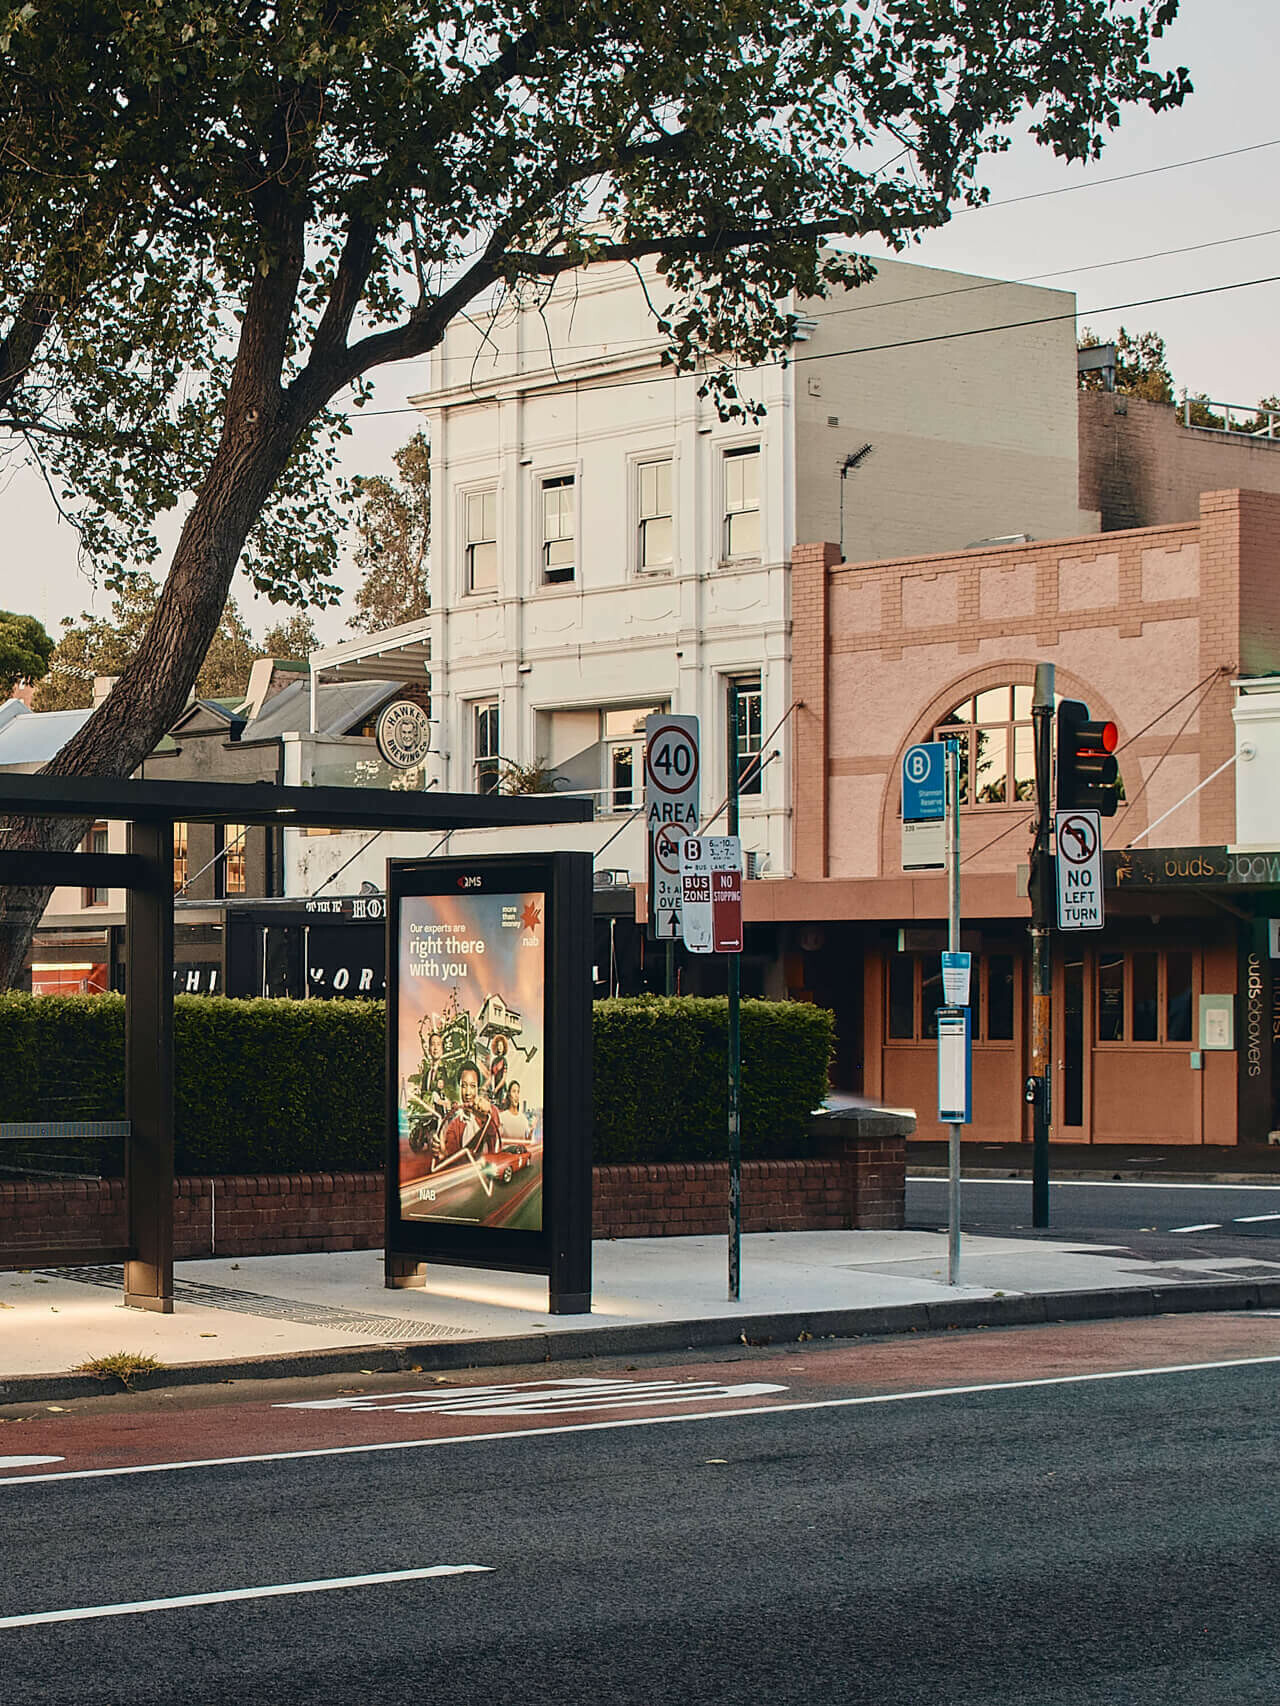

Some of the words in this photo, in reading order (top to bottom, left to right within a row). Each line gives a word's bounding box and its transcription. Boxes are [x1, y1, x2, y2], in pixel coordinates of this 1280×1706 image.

[387, 739, 420, 762] BREWING
[654, 744, 691, 777] 40
[913, 756, 923, 776] B
[648, 802, 697, 823] AREA
[687, 840, 699, 860] B
[685, 877, 708, 888] BUS
[720, 875, 733, 888] NO
[1067, 870, 1092, 887] NO
[684, 890, 710, 901] ZONE
[713, 891, 741, 902] STOPPING
[1065, 891, 1095, 904] LEFT
[352, 899, 387, 918] HO
[660, 897, 682, 908] OVE
[1064, 908, 1097, 921] TURN
[410, 923, 423, 933] Our
[424, 924, 452, 935] experts
[452, 924, 466, 933] are
[501, 920, 521, 928] money
[410, 936, 443, 958] right
[445, 936, 485, 954] there
[522, 936, 539, 947] nab
[410, 959, 439, 977] with
[442, 962, 468, 981] you
